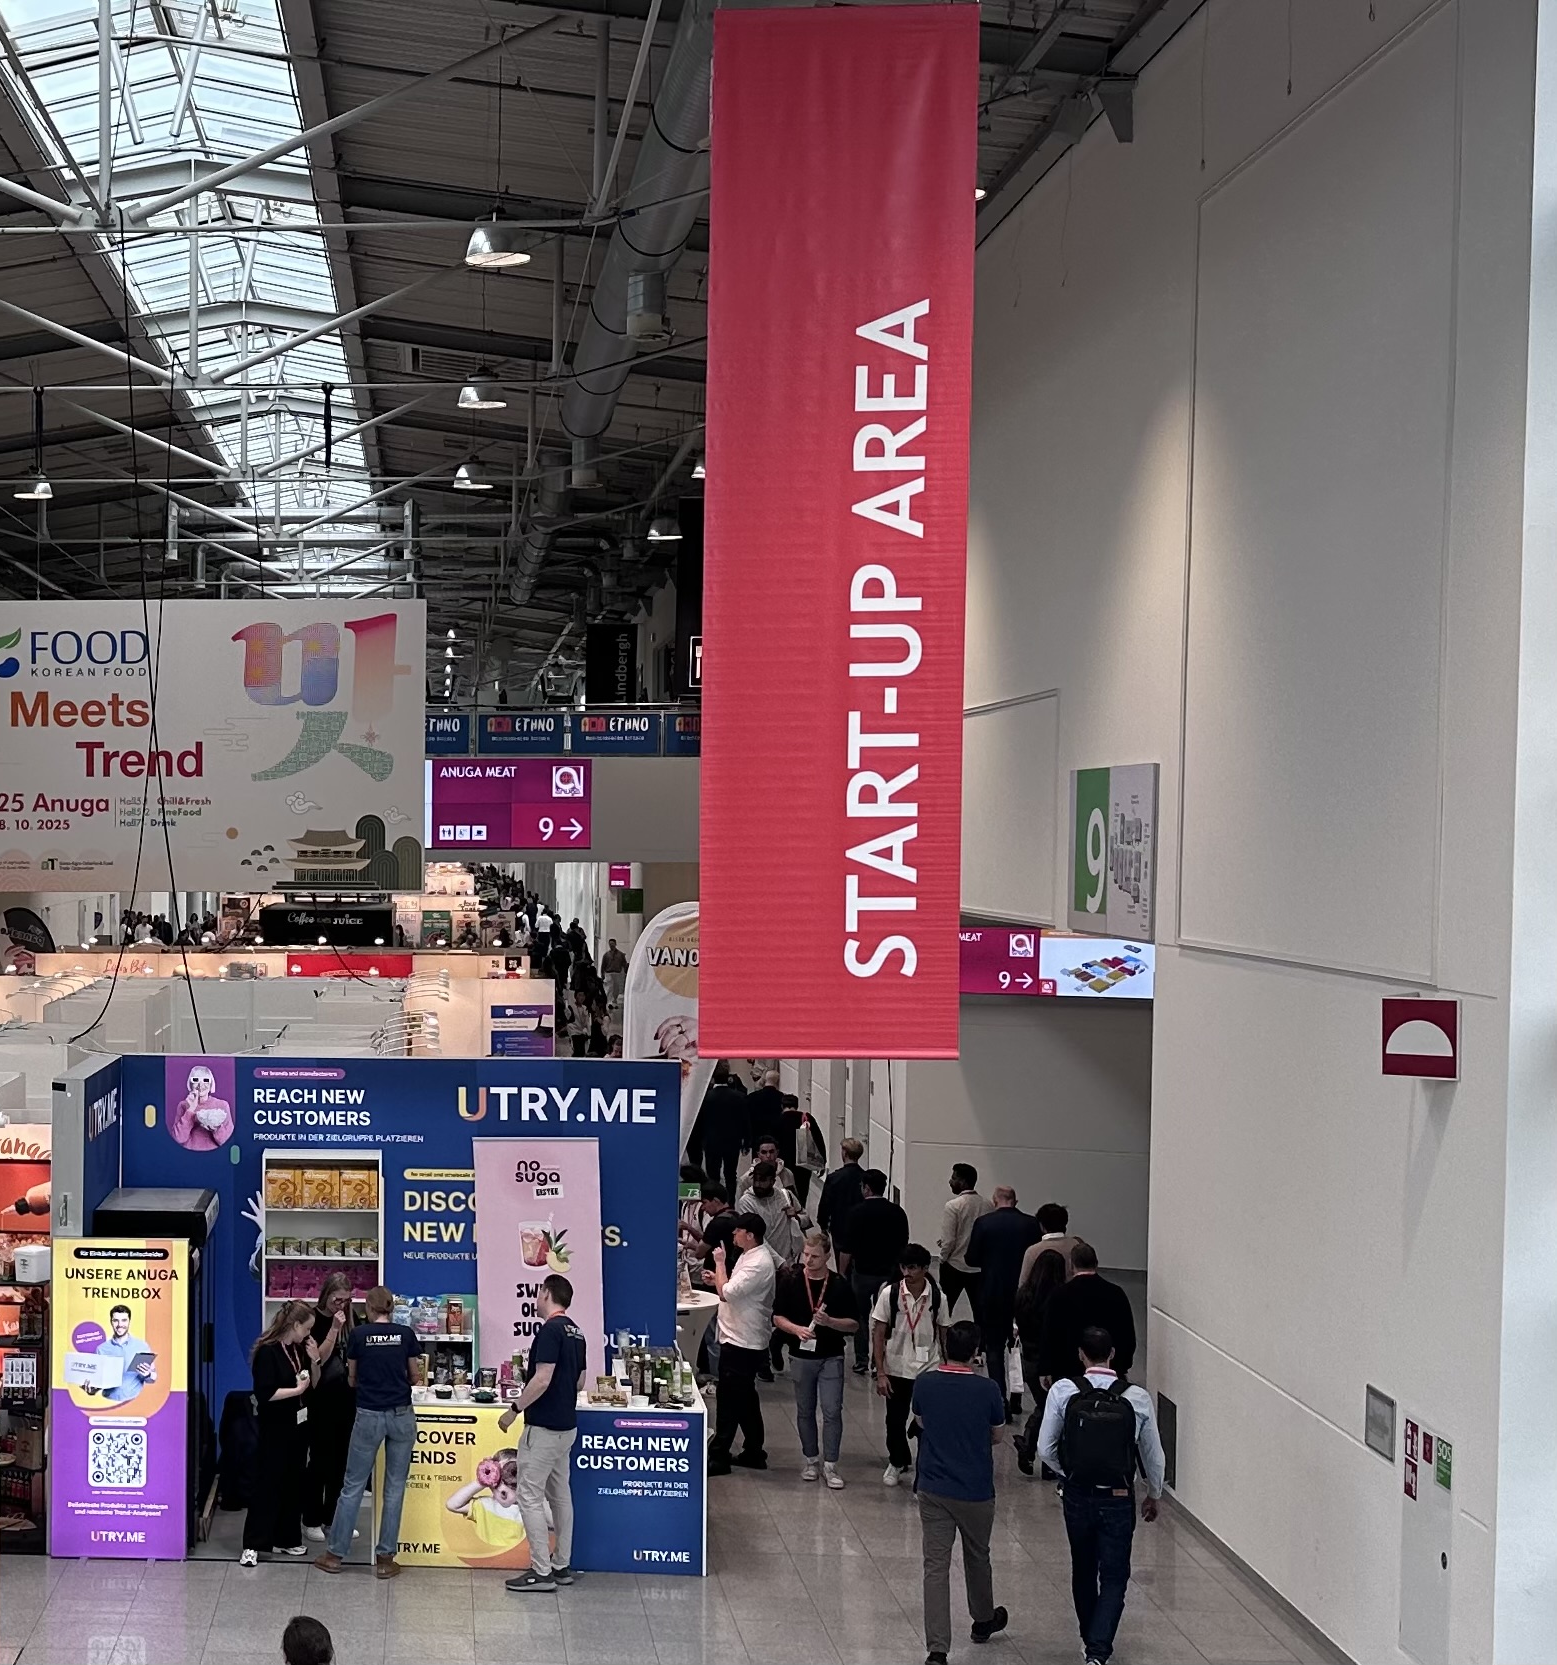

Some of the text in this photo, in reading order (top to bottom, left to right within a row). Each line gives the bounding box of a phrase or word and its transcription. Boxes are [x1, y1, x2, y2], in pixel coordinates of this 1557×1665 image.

[843, 297, 932, 979] START-UP AREA
[31, 668, 147, 678] KOREAN FOOD
[10, 691, 150, 728] Meets
[515, 717, 555, 733] ETHNO
[609, 716, 649, 732] ETHNO
[76, 741, 204, 778] Trend
[440, 766, 517, 778] ANUGA MEAT
[33, 793, 110, 818] Anuga
[37, 819, 71, 831] 2025
[150, 819, 177, 827] Drink
[538, 817, 554, 841] 9
[1086, 807, 1107, 914] 9
[287, 911, 315, 925] Coffee
[333, 913, 364, 925] JUICE
[998, 972, 1011, 989] 9
[253, 1088, 365, 1105] REACH NEW
[457, 1086, 657, 1124] UTRY.ME
[87, 1087, 118, 1142] UTRY.ME
[253, 1110, 371, 1127] CUSTOMERS
[253, 1133, 296, 1141] PRODUKTE
[308, 1134, 324, 1142] DER
[325, 1134, 374, 1142] ZIELGRUPPE
[375, 1134, 424, 1143] PLATZIEREN
[517, 1160, 541, 1172] no
[515, 1171, 561, 1187] suga
[403, 1222, 465, 1243] NEW
[403, 1252, 471, 1260] NEUE PRODUKTE
[65, 1268, 178, 1281] UNSERE ANUGA
[82, 1287, 161, 1299] TRENDBOX
[582, 1435, 689, 1452] REACH NEW
[1437, 1440, 1453, 1463] SOS
[577, 1454, 690, 1472] CUSTOMERS
[597, 1487, 689, 1498] ZIELGRUPPE PLATZIEREN
[622, 1480, 689, 1489] PRODUKTE IN DER
[91, 1531, 146, 1543] UTRY.ME
[633, 1550, 691, 1563] UTRY.ME
